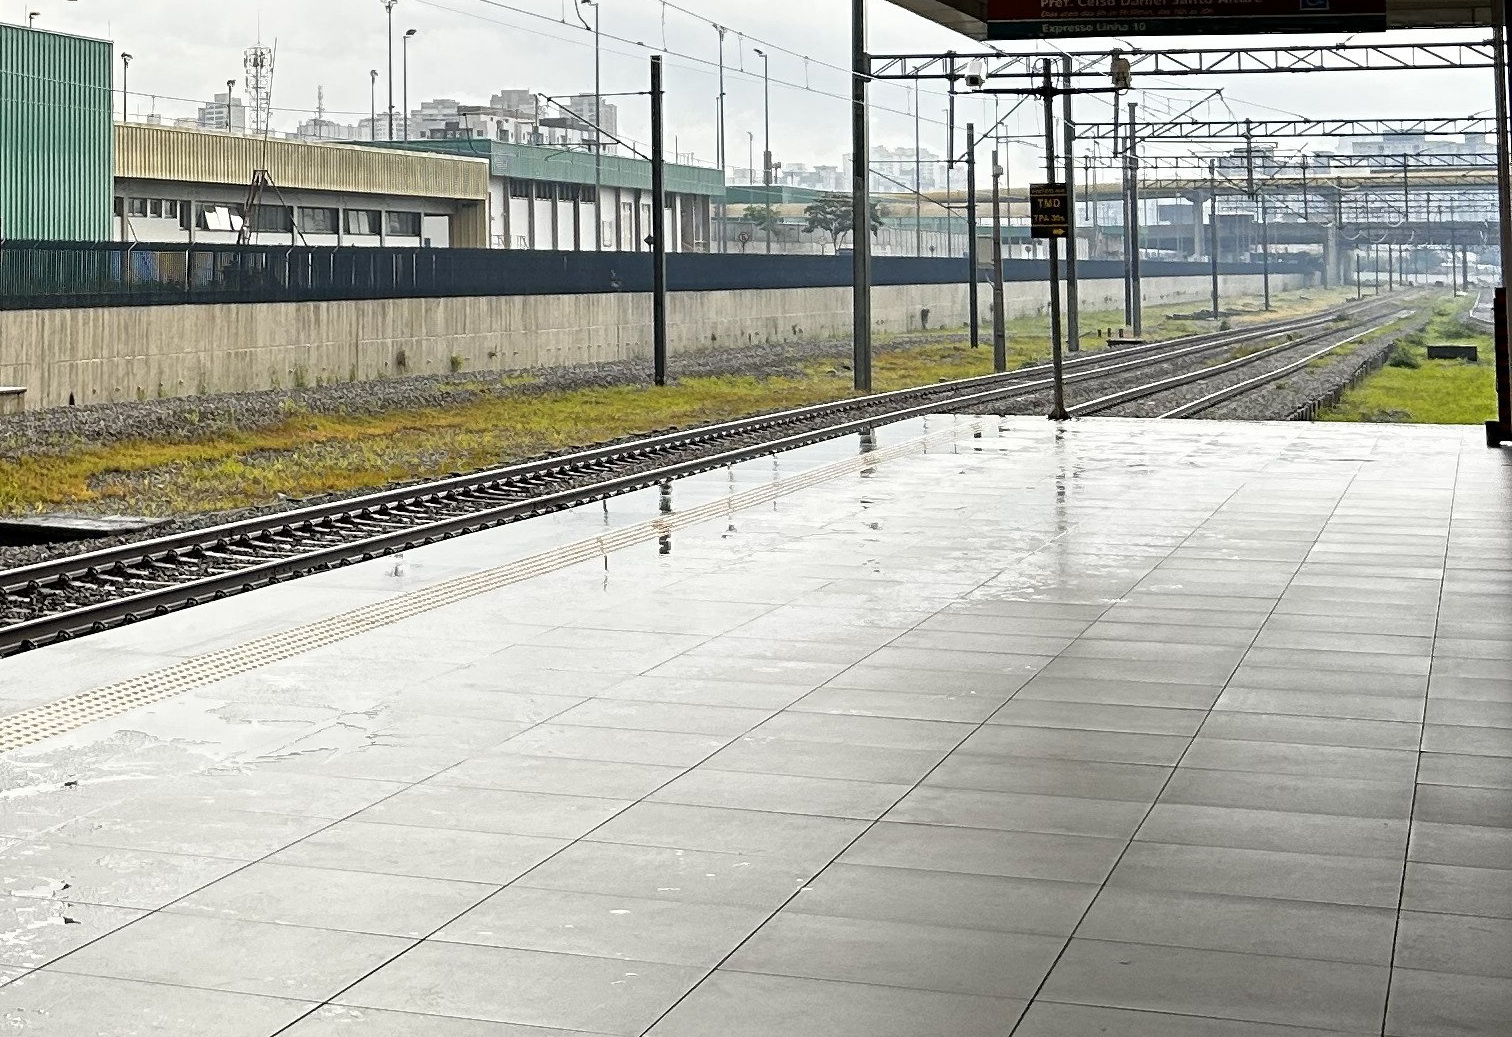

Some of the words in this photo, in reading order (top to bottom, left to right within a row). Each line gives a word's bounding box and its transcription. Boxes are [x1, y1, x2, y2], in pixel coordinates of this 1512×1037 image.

[1041, 23, 1094, 34] Expresso
[1096, 22, 1129, 33] Linha
[1133, 21, 1147, 31] 10
